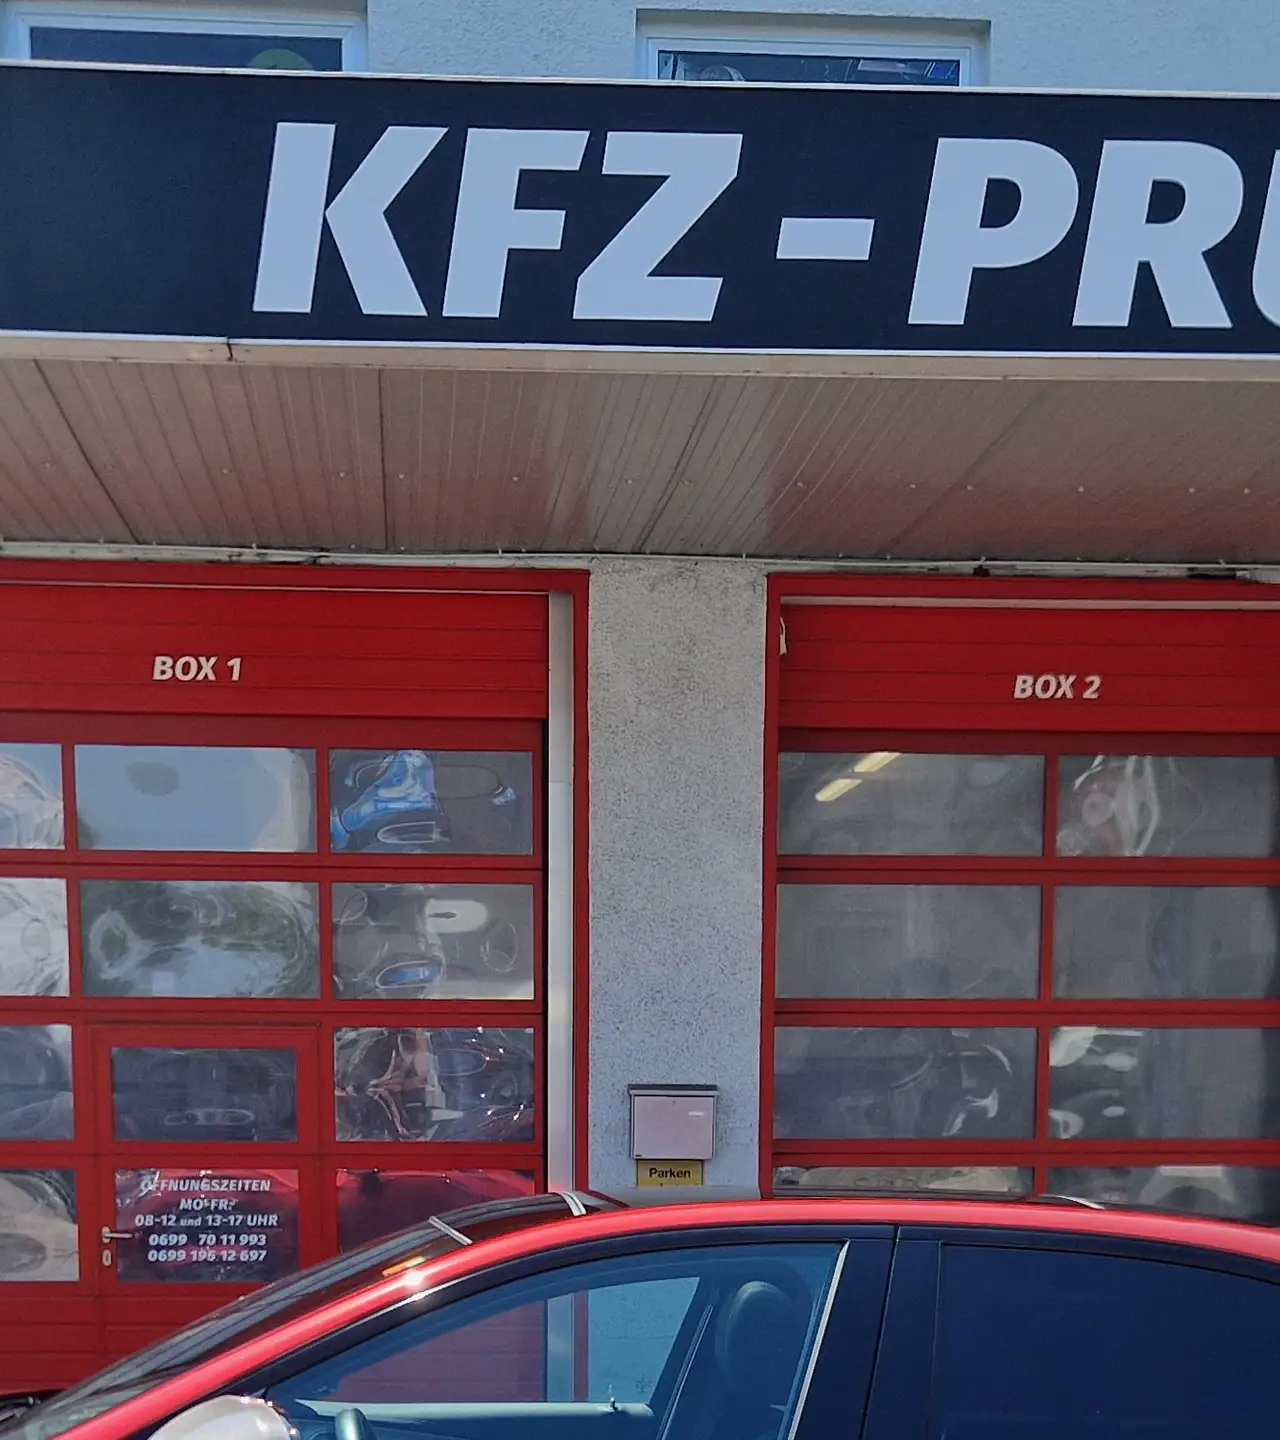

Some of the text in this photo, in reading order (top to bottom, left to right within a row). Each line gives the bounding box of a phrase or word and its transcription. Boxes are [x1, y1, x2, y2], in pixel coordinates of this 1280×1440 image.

[152, 655, 242, 681] BOX 1
[1013, 674, 1101, 699] BOX 2
[648, 1167, 691, 1179] Parken
[140, 1175, 271, 1191] ÖFFNUNGSZEITEN
[135, 1214, 278, 1226] 08-12 und 13-17 UHR
[148, 1233, 267, 1246] 0699 70 11 993
[147, 1249, 186, 1262] 0699
[220, 1249, 237, 1262] 12
[239, 1249, 268, 1262] 697
